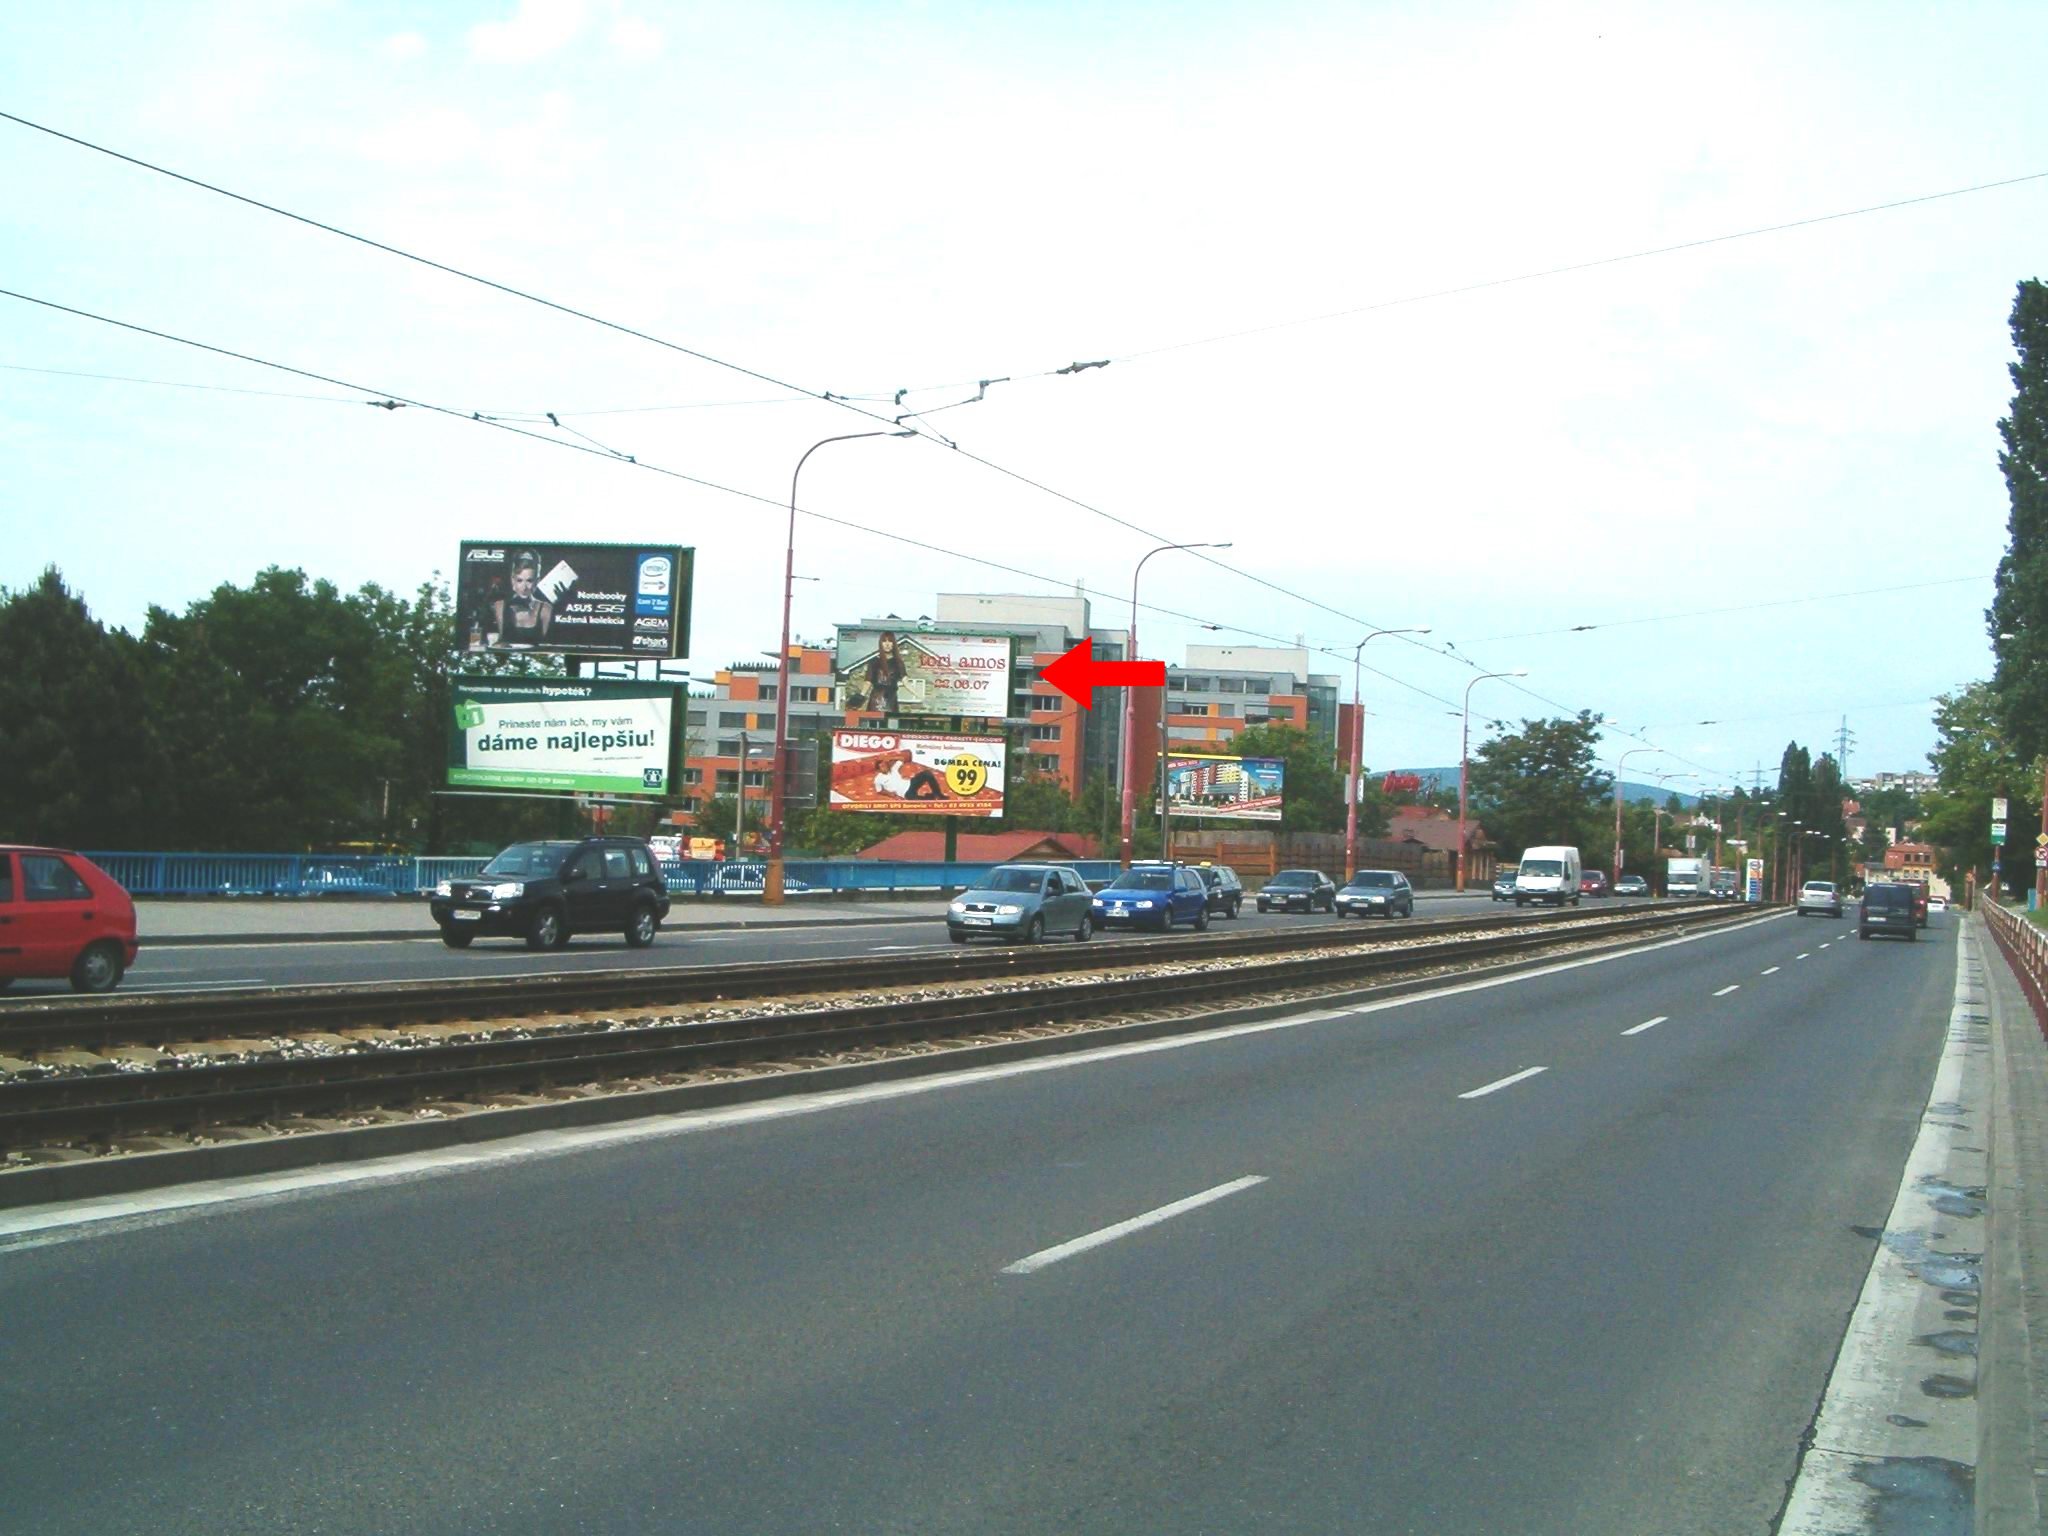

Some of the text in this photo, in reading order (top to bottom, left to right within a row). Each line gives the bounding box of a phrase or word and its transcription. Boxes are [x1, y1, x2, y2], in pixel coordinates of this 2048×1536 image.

[577, 591, 627, 602] Notebooky
[566, 604, 592, 612] ASUS
[919, 653, 1006, 669] tori amos
[499, 716, 633, 729] Prineste nám ich, my vám
[478, 729, 655, 752] dáme najlepšiu!
[840, 734, 898, 750] DIEGO
[934, 758, 1002, 768] BOMBA CENA!
[956, 768, 977, 786] 99
